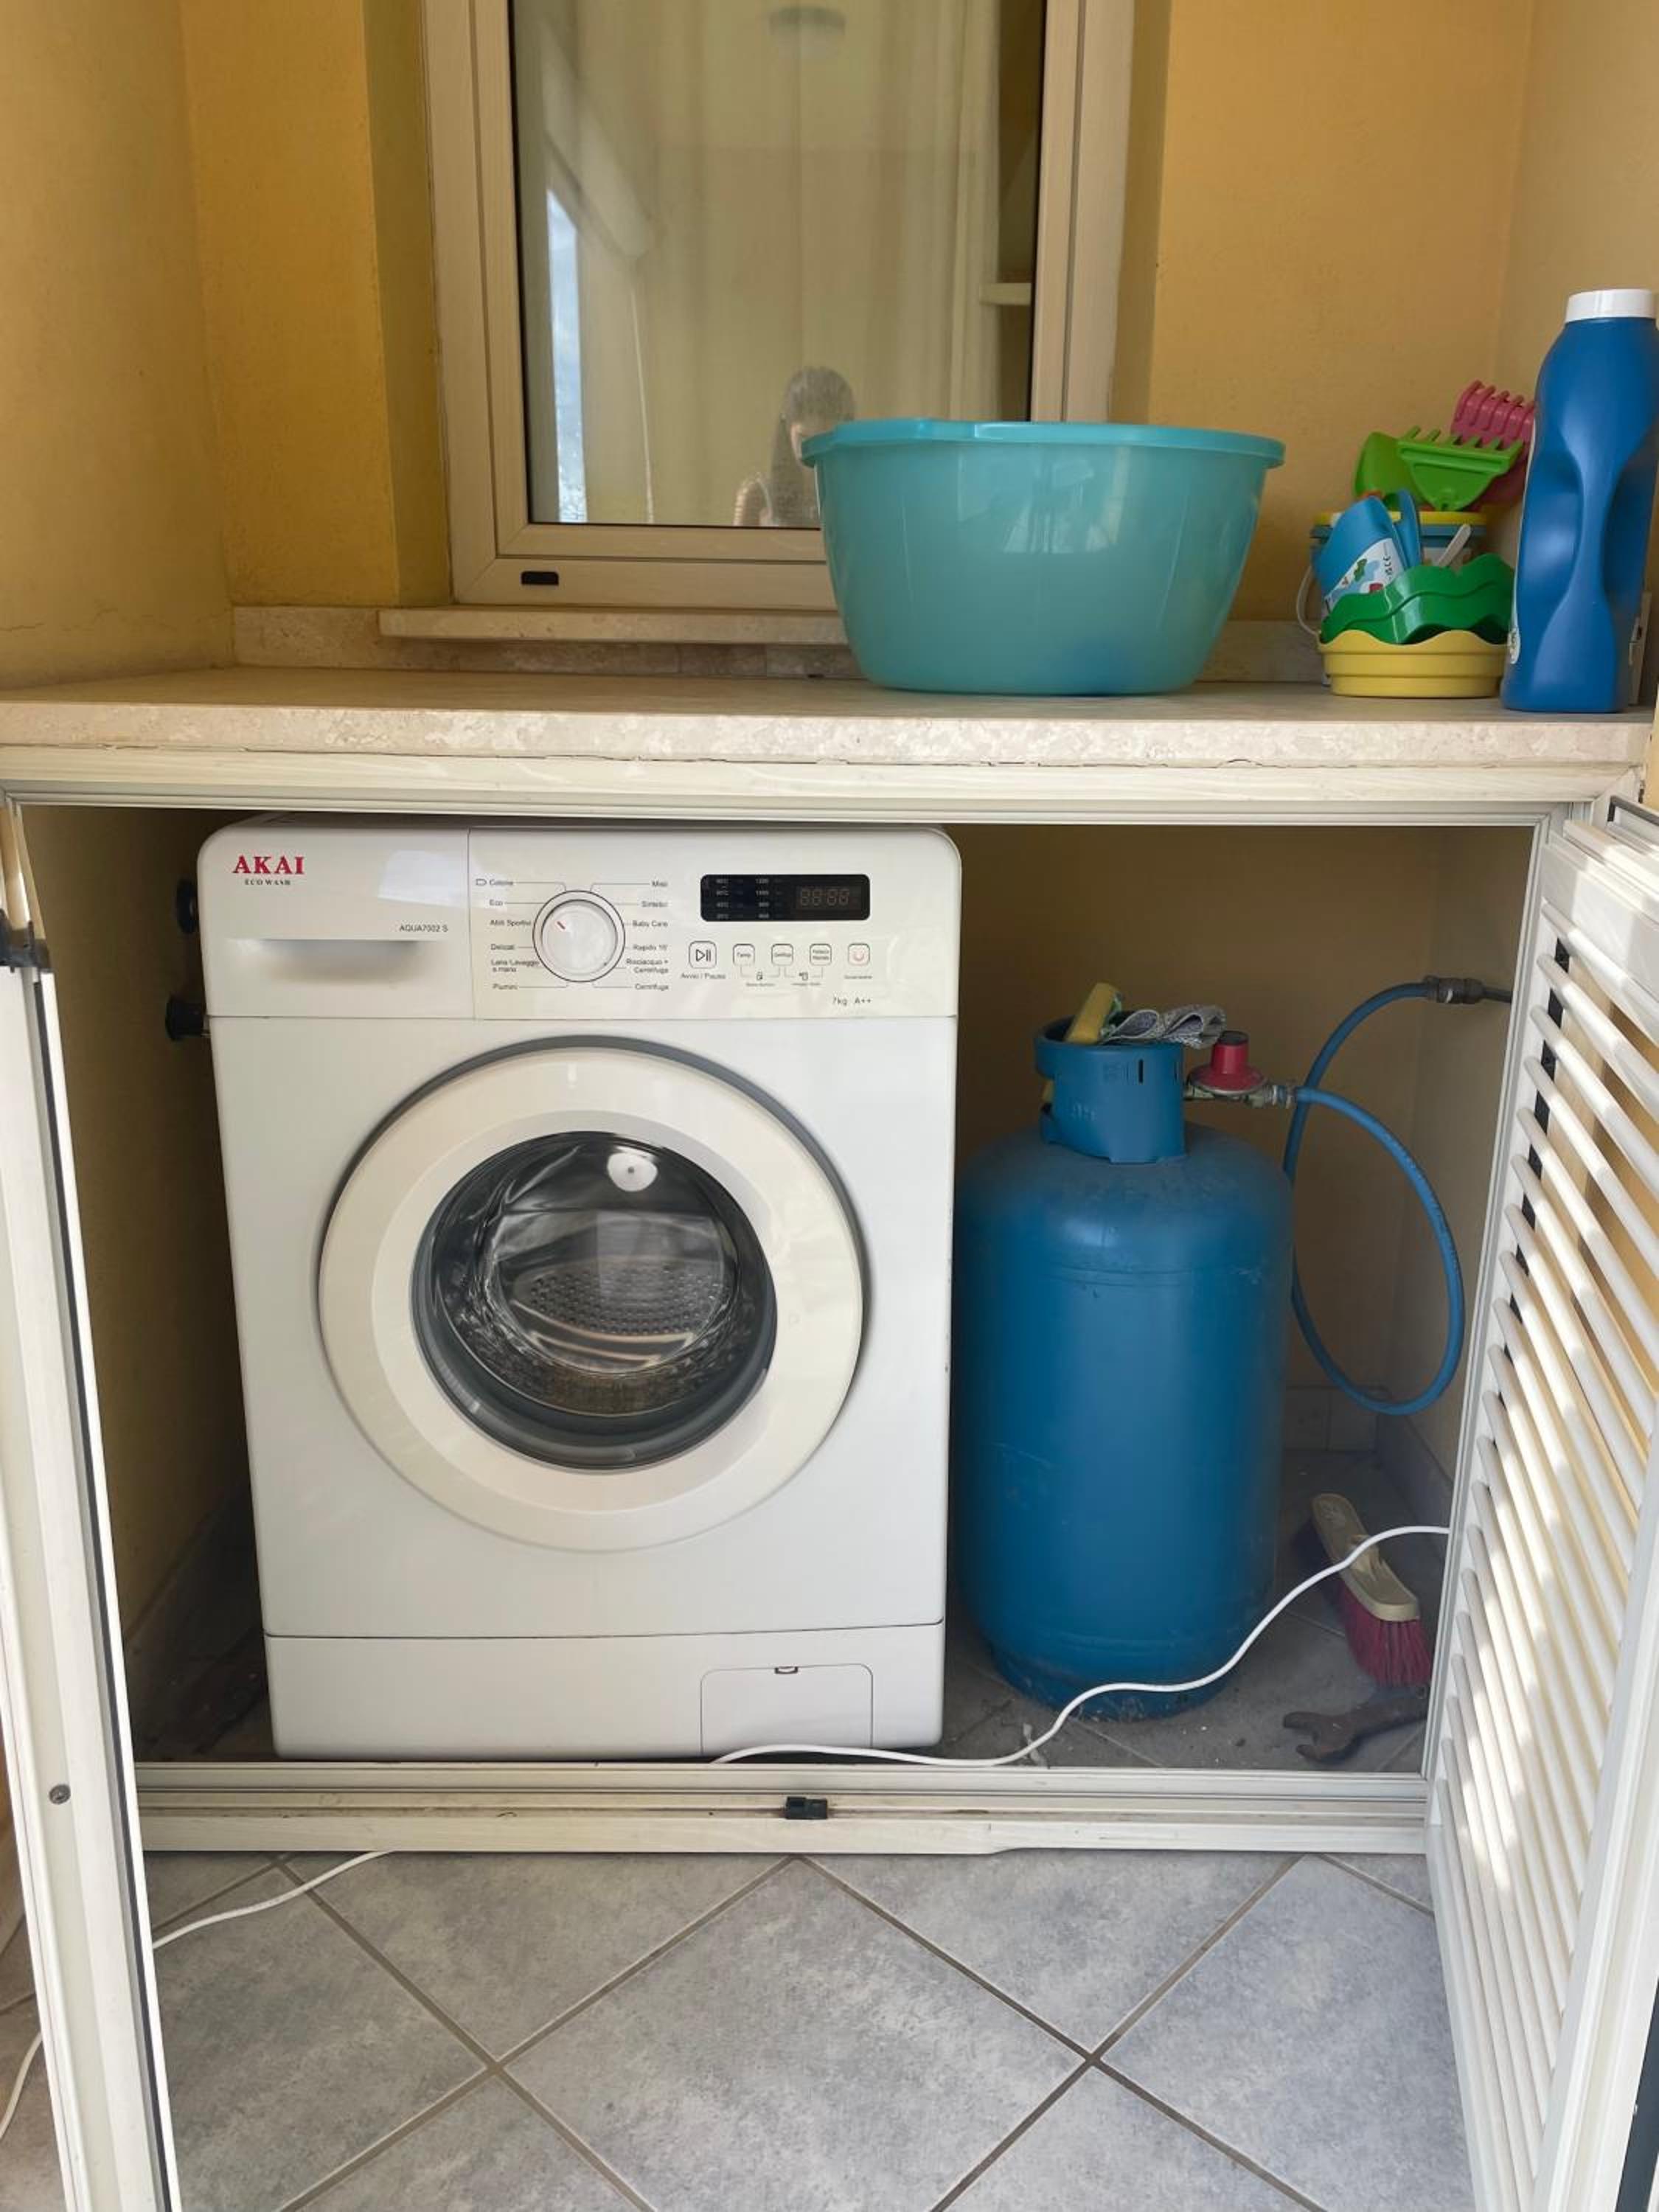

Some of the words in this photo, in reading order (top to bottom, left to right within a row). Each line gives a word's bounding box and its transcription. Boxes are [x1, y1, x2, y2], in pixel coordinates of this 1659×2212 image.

[232, 855, 305, 874] AKAI
[509, 959, 540, 967] Lavaggio
[633, 967, 669, 975] Centrifuga
[635, 983, 669, 992] Centrifuga
